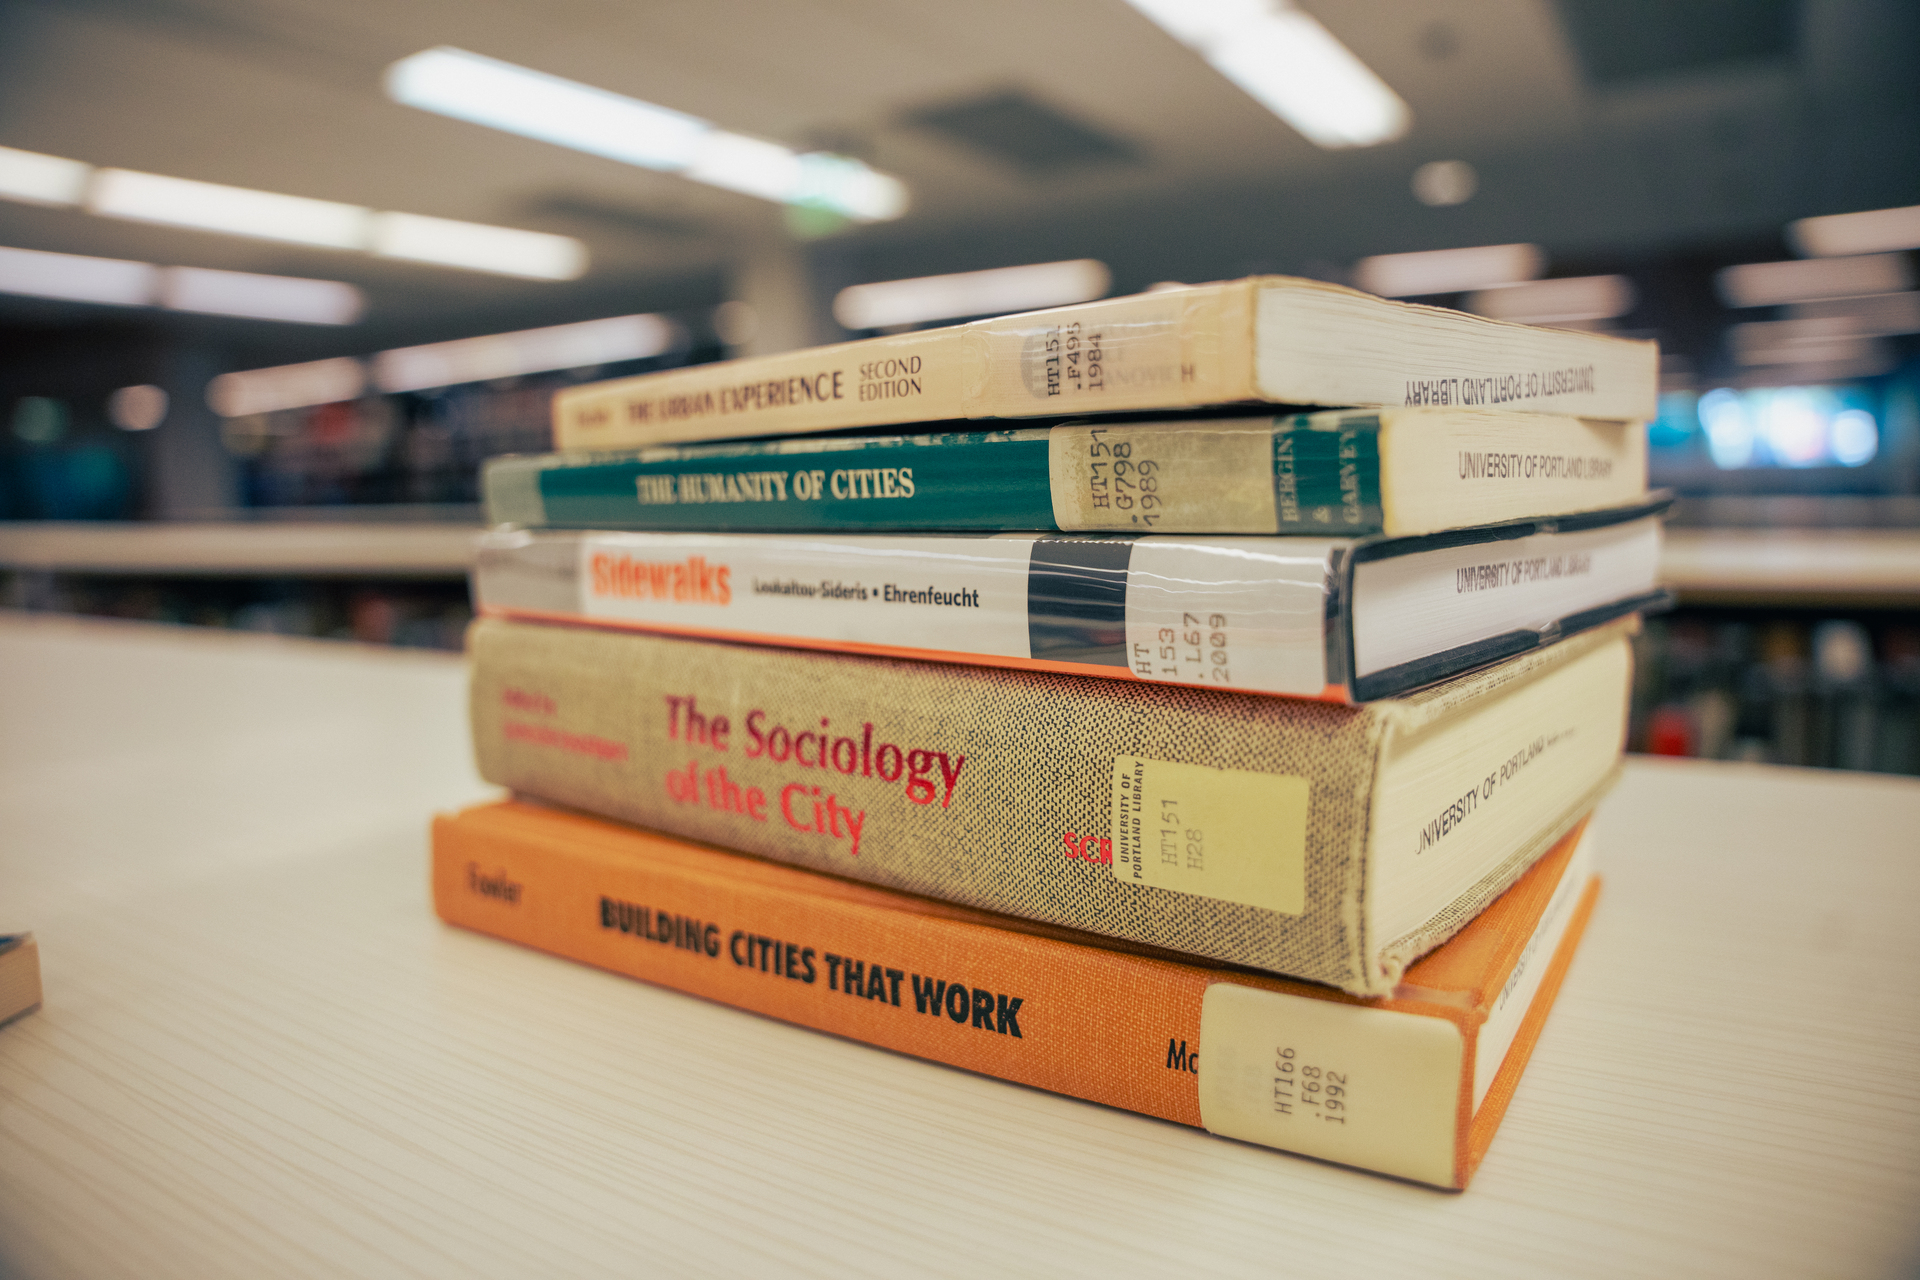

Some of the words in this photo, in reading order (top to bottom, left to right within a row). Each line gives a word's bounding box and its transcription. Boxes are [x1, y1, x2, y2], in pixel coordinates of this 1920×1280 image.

[859, 355, 922, 381] SECOND
[1046, 324, 1061, 397] HT151
[1087, 333, 1104, 392] 1984
[1524, 373, 1538, 398] OF
[1540, 363, 1596, 396] UNIVERSITY
[719, 370, 845, 416] EXPERIENCE
[859, 377, 923, 402] EDITION
[1404, 378, 1459, 408] LIBRARY
[1462, 374, 1522, 405] PORTLAND
[635, 473, 677, 505] THE
[677, 471, 789, 504] HUMANITY
[792, 469, 825, 501] OF
[830, 467, 916, 500] CITIES
[1090, 429, 1111, 509] HT151
[1458, 450, 1524, 480] UNIVERSITY
[1525, 454, 1538, 479] OF
[1539, 454, 1583, 480] PORTLAND
[592, 552, 732, 606] Sidewalks
[883, 584, 980, 608] Ehrenfeucht
[1456, 561, 1511, 594] UNIVERSITY
[1511, 560, 1523, 585] OF
[1133, 643, 1152, 675] HT
[1158, 627, 1178, 676] 153
[1208, 613, 1230, 683] 2009
[664, 694, 731, 753] The
[745, 709, 966, 808] Sociology
[1482, 771, 1497, 801] OF
[1499, 735, 1544, 787] PORTLAND
[1121, 773, 1131, 790] OF
[1132, 760, 1145, 813] LIBRARY
[665, 761, 700, 806] of
[705, 765, 769, 823] the
[780, 783, 866, 856] City
[1120, 793, 1130, 863] UNIVERSITY
[1160, 799, 1181, 867] HT151
[1132, 817, 1143, 880] PORTLAND
[1185, 827, 1204, 872] H28
[600, 894, 721, 958] BUILDING
[730, 929, 816, 984] CITIES
[824, 951, 904, 1008] THAT
[911, 973, 1024, 1039] WORK
[1274, 1046, 1296, 1116] HT166
[1324, 1070, 1347, 1125] 1992
